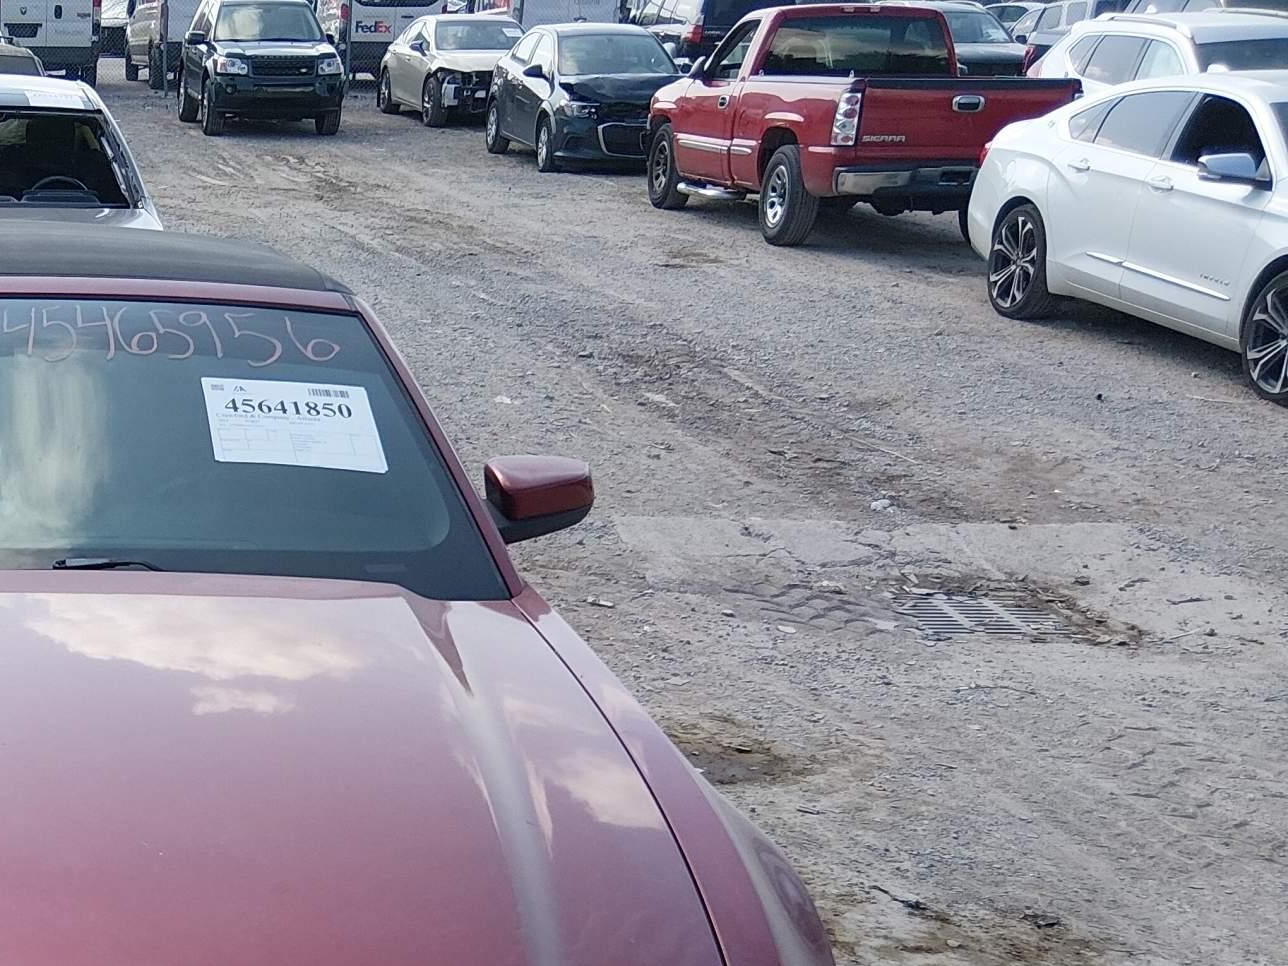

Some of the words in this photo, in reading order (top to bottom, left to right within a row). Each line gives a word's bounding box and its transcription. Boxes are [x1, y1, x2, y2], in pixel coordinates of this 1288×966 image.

[355, 20, 392, 33] FedEx
[862, 135, 906, 143] SIERRA
[3, 305, 341, 367] 45465956
[224, 397, 352, 419] 45641850
